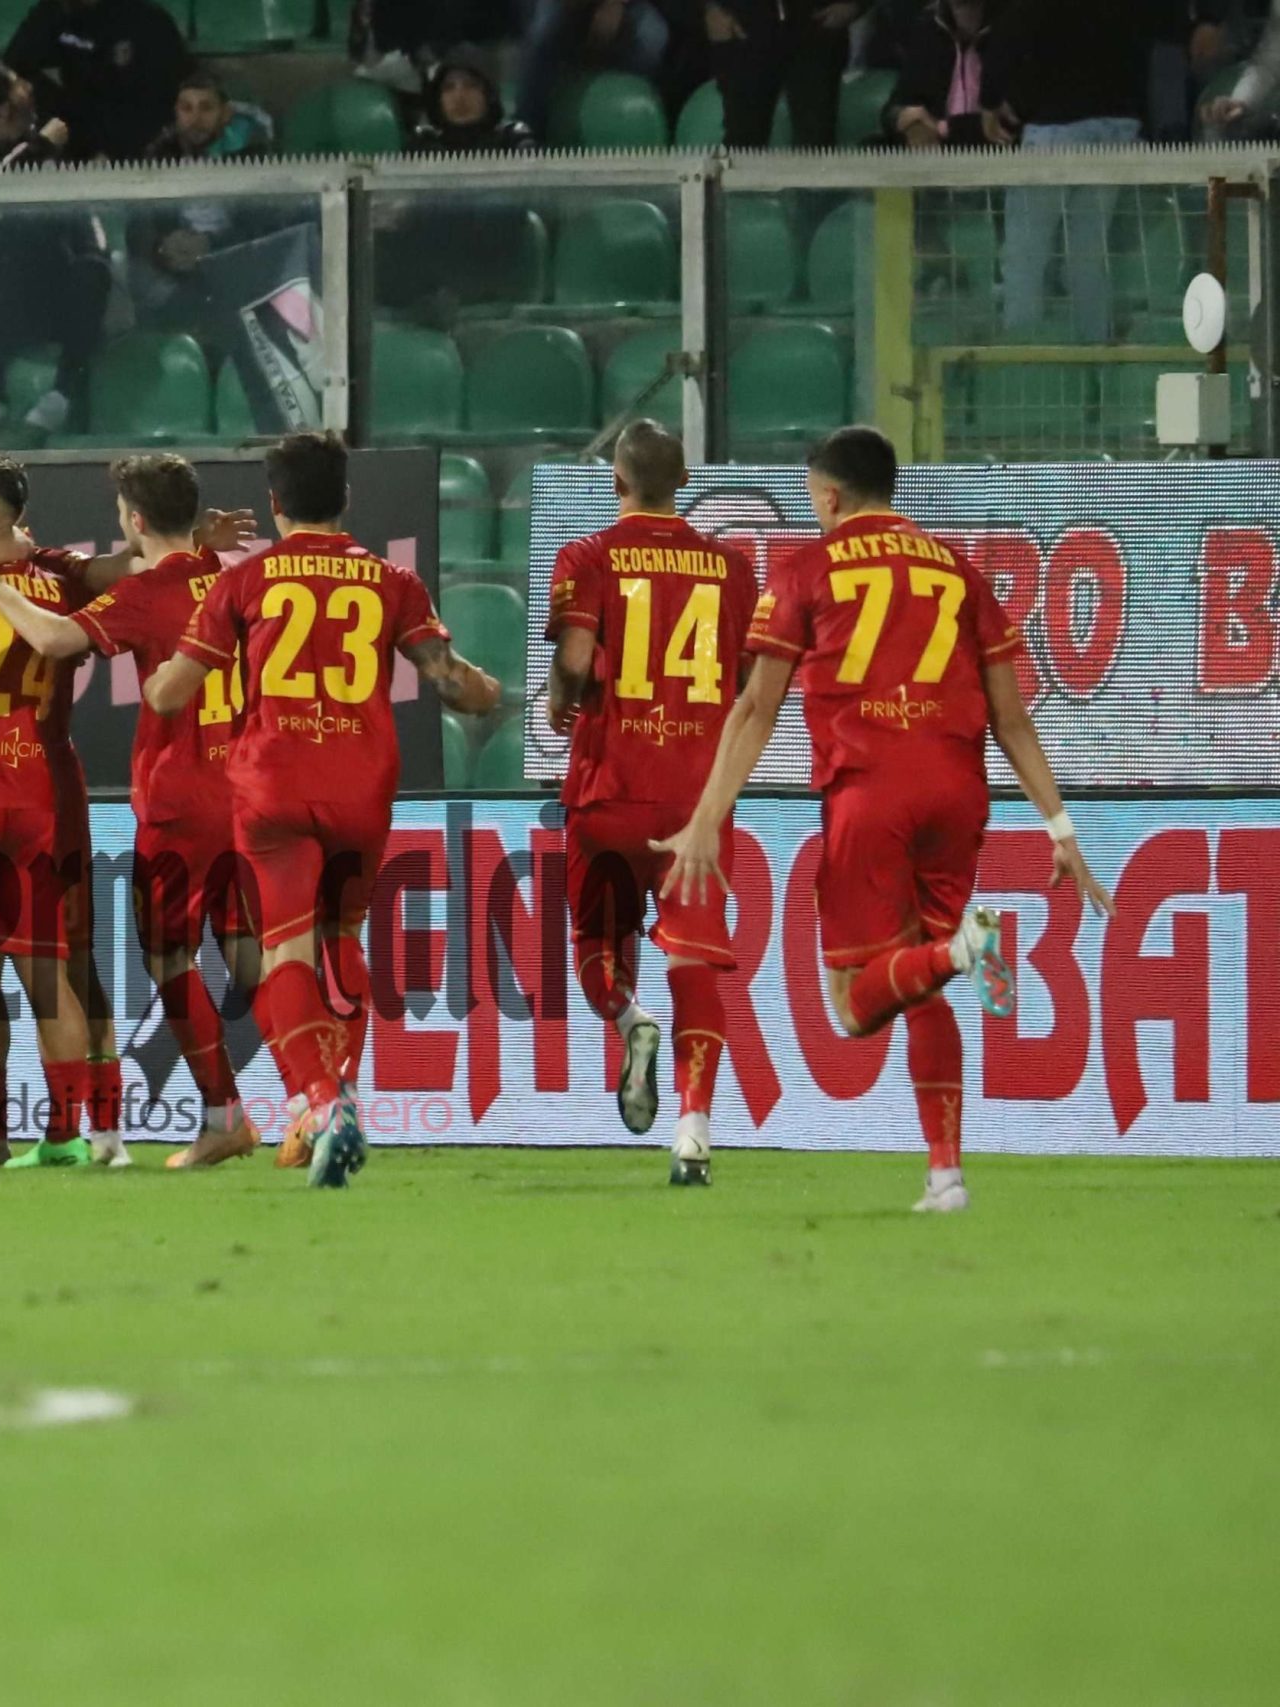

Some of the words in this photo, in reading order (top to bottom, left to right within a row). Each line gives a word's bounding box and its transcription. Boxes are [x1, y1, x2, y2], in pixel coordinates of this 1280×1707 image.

[609, 548, 728, 579] SCOGNAMILLO
[826, 532, 956, 567] KATSERIS
[263, 554, 382, 583] BRIGHENTI
[615, 577, 723, 705] 14
[829, 565, 967, 685] 77
[261, 582, 384, 705] 23
[278, 714, 363, 734] PRINCIPE
[621, 718, 704, 737] PRINCIPE
